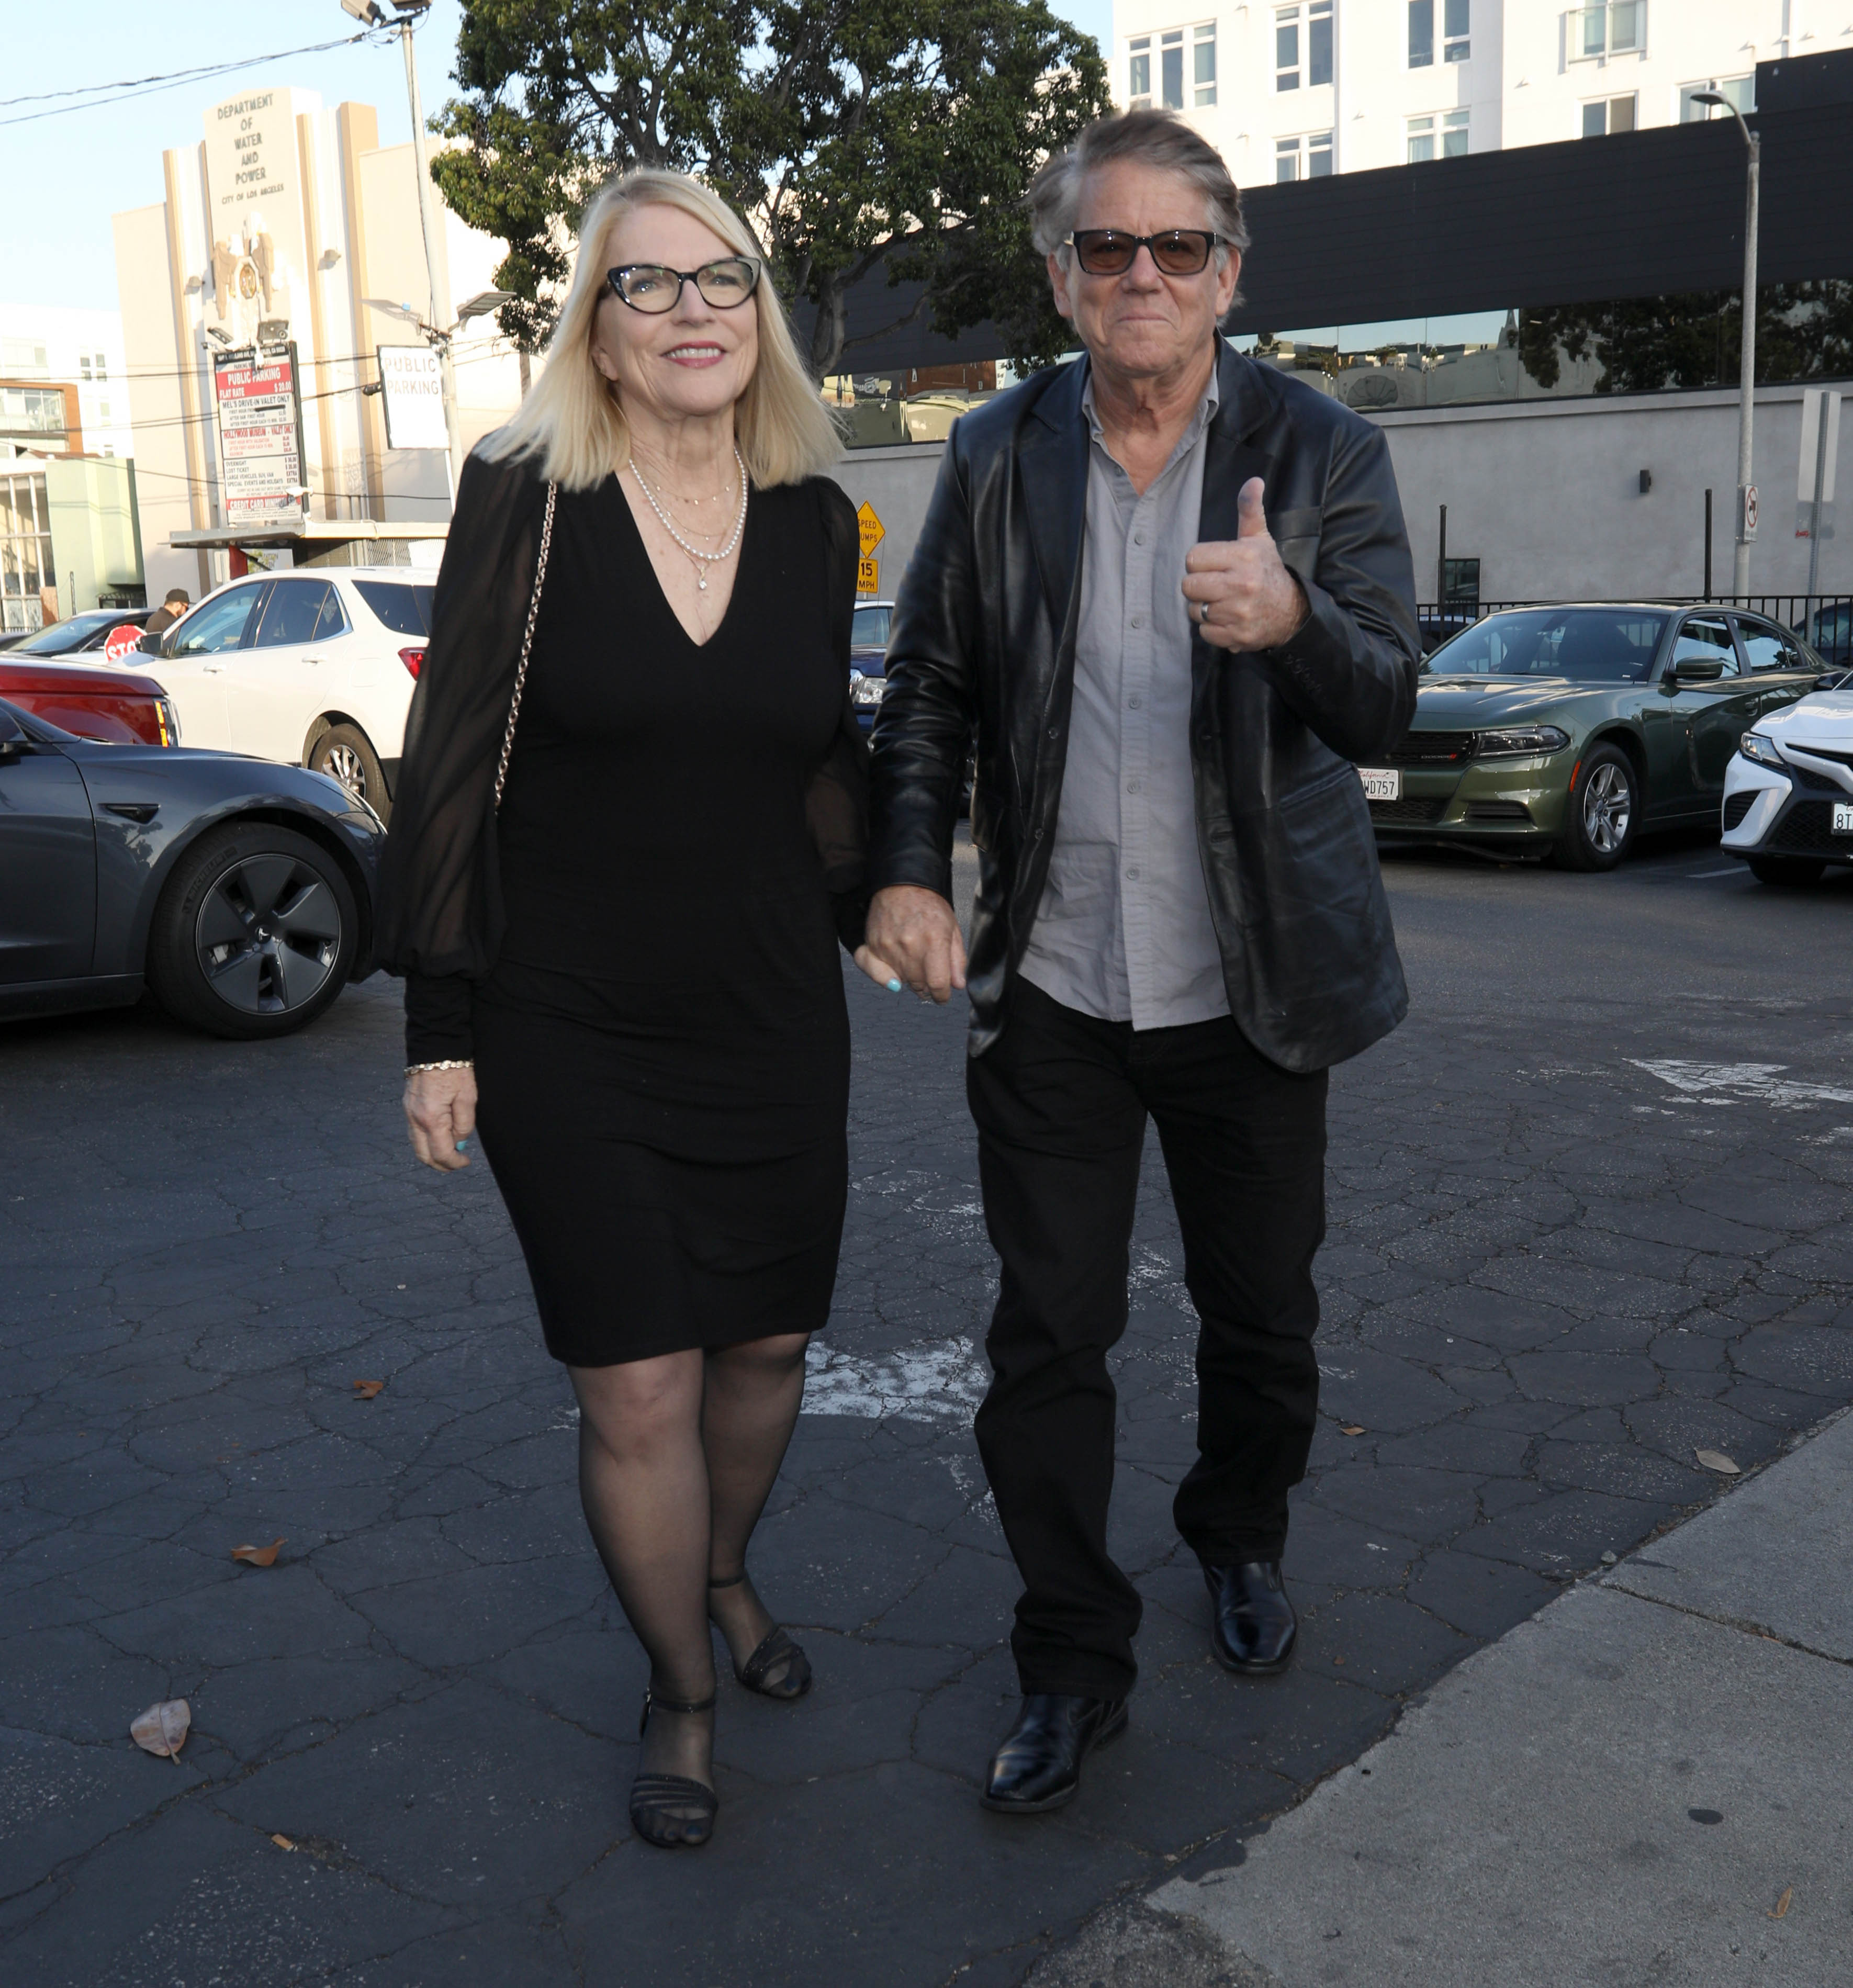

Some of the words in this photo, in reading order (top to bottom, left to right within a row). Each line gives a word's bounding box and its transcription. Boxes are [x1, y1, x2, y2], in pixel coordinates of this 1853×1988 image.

[218, 93, 273, 120] DEPARTMENT
[240, 117, 253, 131] OF
[234, 132, 263, 150] WATER
[241, 151, 259, 166] AND
[235, 167, 266, 184] POWER
[222, 195, 233, 205] CITY
[237, 193, 244, 201] OF
[247, 189, 257, 199] LOS
[261, 184, 284, 196] ANGELES
[385, 357, 436, 373] PUBLIC
[227, 371, 251, 386] PUBLIC
[252, 367, 281, 383] PARKING
[219, 388, 232, 399] FLAT
[232, 387, 245, 398] RATE
[278, 381, 291, 392] 20.00
[387, 380, 439, 395] PARKING
[222, 400, 238, 409] MEL'S
[238, 398, 260, 407] DRIVE-IN
[261, 396, 275, 405] VALET
[277, 394, 290, 402] ONLY
[223, 428, 248, 439] HOLLYWOOD
[249, 425, 266, 437] MUSEUM
[271, 424, 283, 435] VALET
[284, 423, 294, 434] ONLY
[230, 500, 249, 510] CREDIT
[250, 499, 264, 509] CARD
[265, 497, 289, 508] MINIMUM
[860, 533, 878, 542] UMPS
[861, 562, 873, 576] 15
[859, 580, 874, 589] MPH
[108, 636, 140, 659] STO
